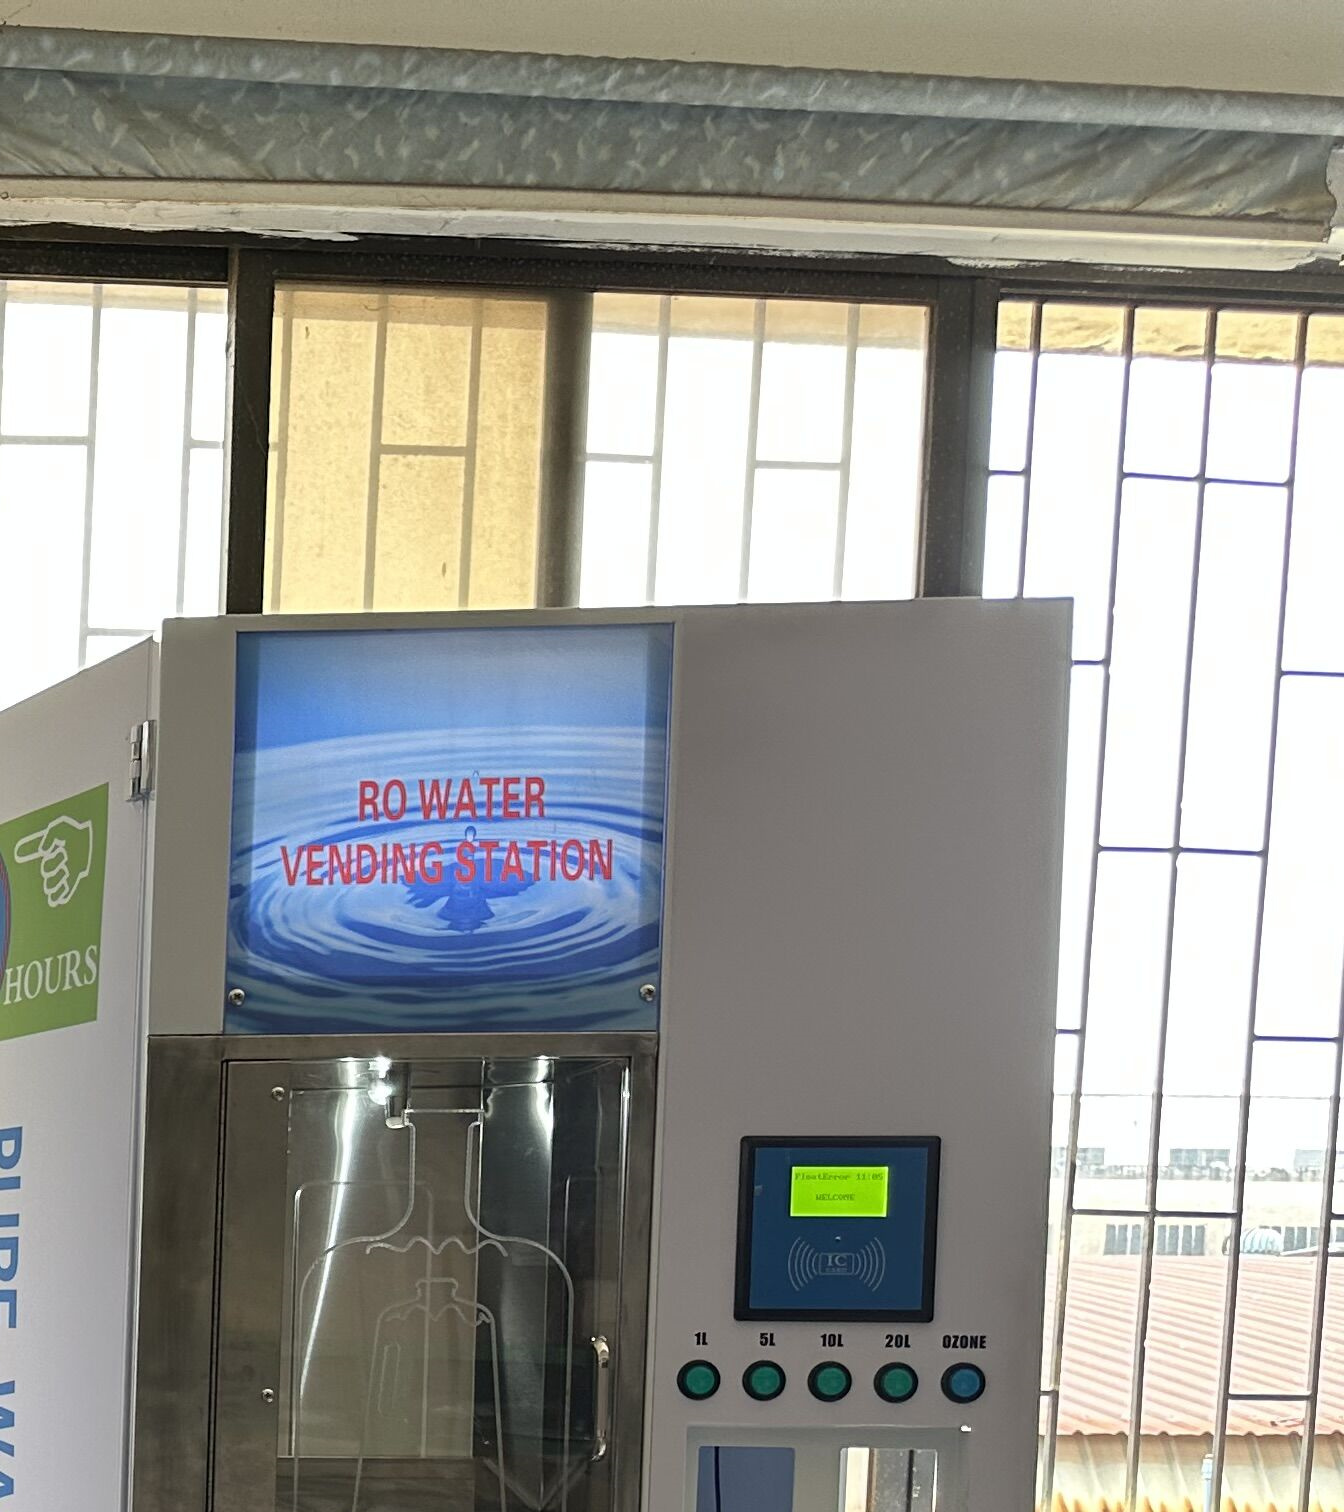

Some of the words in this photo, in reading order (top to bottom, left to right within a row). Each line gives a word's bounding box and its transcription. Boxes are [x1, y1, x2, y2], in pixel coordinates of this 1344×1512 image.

[358, 780, 406, 822] RO
[418, 777, 546, 820] WATER
[280, 842, 443, 887] VENDING
[455, 839, 613, 884] STATION
[3, 945, 97, 1005] HOURS
[816, 1193, 855, 1201] WELCOME
[827, 1255, 847, 1267] IC
[694, 1332, 708, 1345] 1L
[759, 1333, 775, 1346] 5L
[820, 1334, 844, 1347] 10L
[885, 1334, 911, 1348] 20L
[942, 1335, 986, 1349] OZONE
